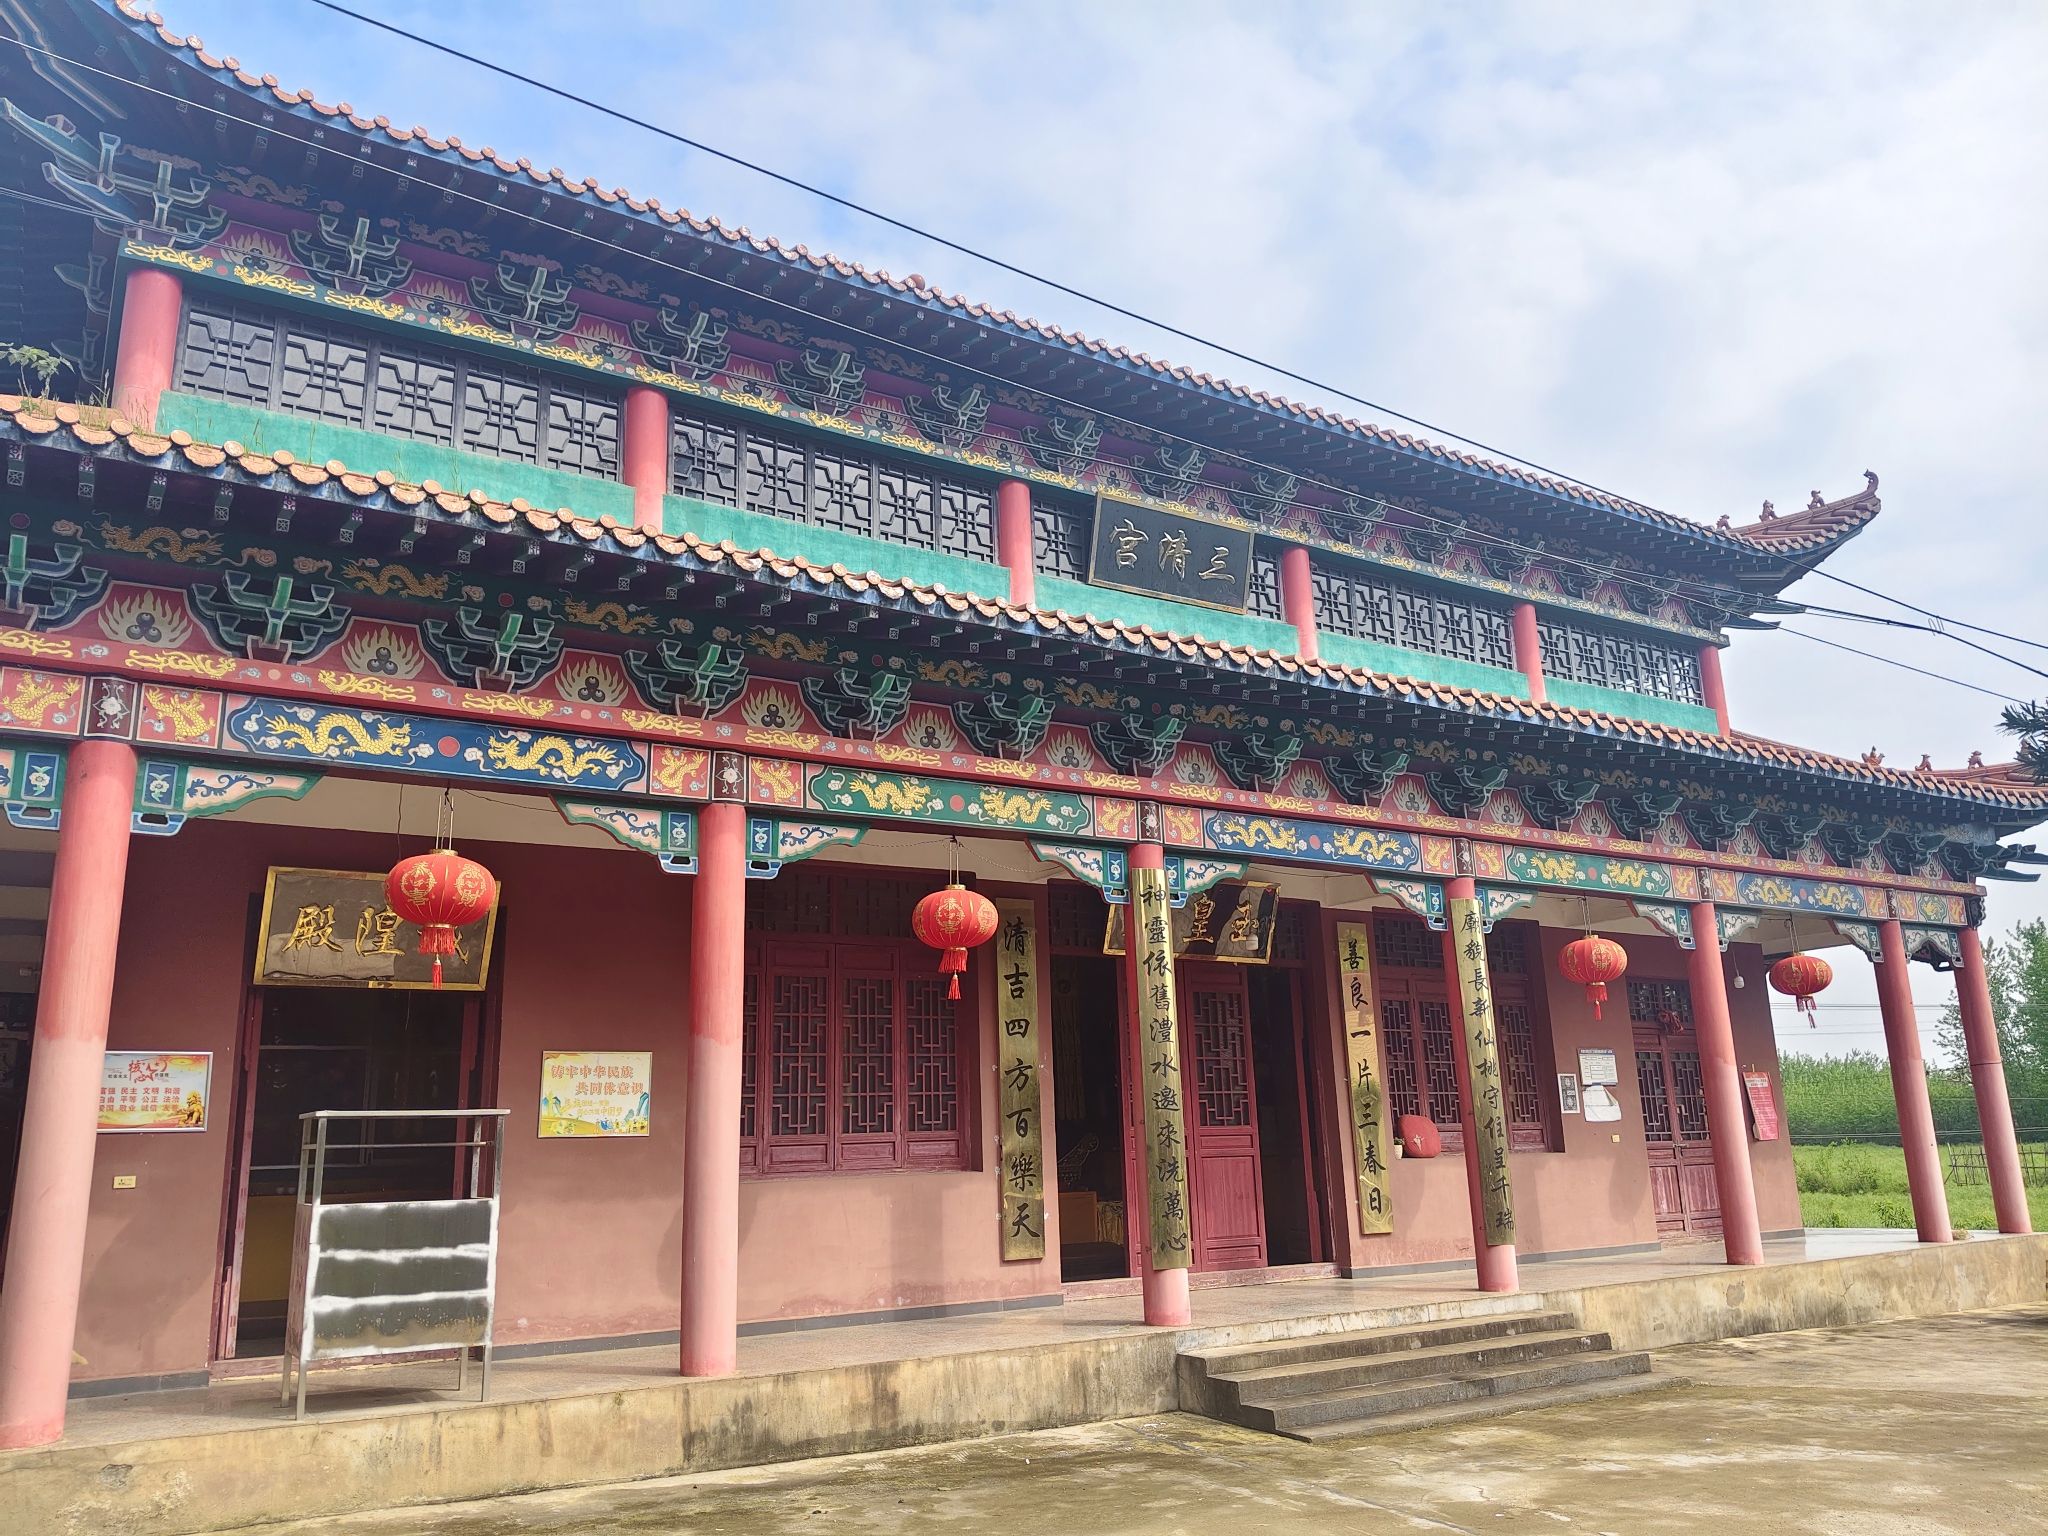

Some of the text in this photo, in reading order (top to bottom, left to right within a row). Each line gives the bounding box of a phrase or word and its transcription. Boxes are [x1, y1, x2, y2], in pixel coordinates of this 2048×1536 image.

[281, 903, 469, 965] 隍殿
[1182, 892, 1260, 944] 玉皇
[1004, 916, 1041, 1239] 清吉四方百樂天
[1343, 938, 1387, 1215] 善良一片三春日
